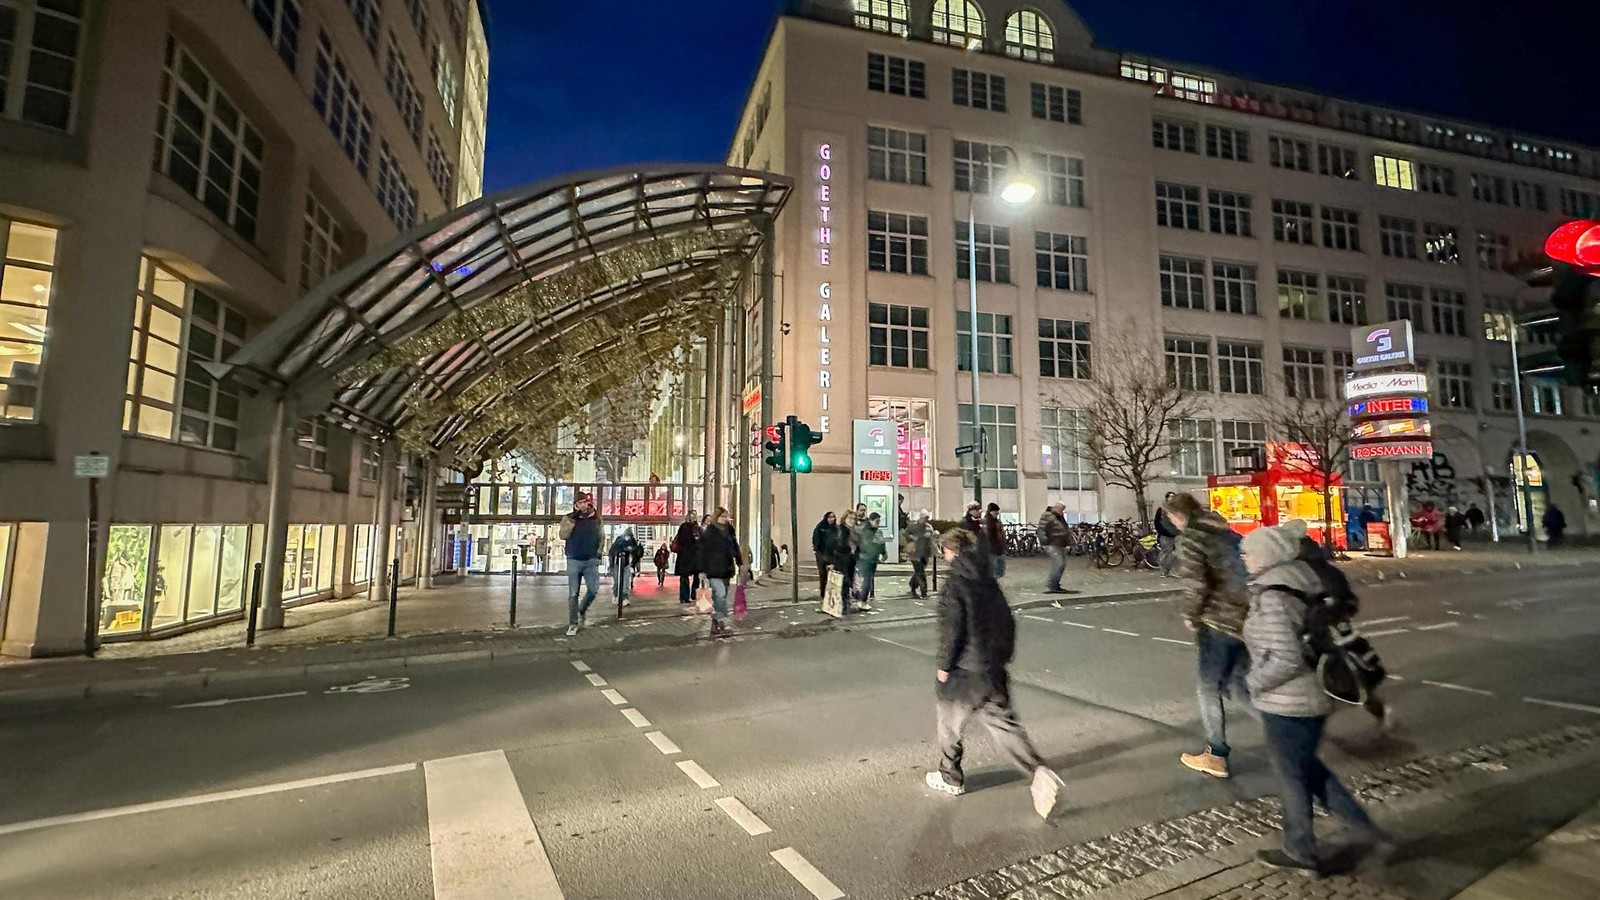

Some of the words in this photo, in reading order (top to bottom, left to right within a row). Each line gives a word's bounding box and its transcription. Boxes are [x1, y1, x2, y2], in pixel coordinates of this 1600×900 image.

[819, 144, 831, 266] GOETHE
[819, 282, 831, 433] GALERIE
[1357, 445, 1422, 458] ROSSMANN
